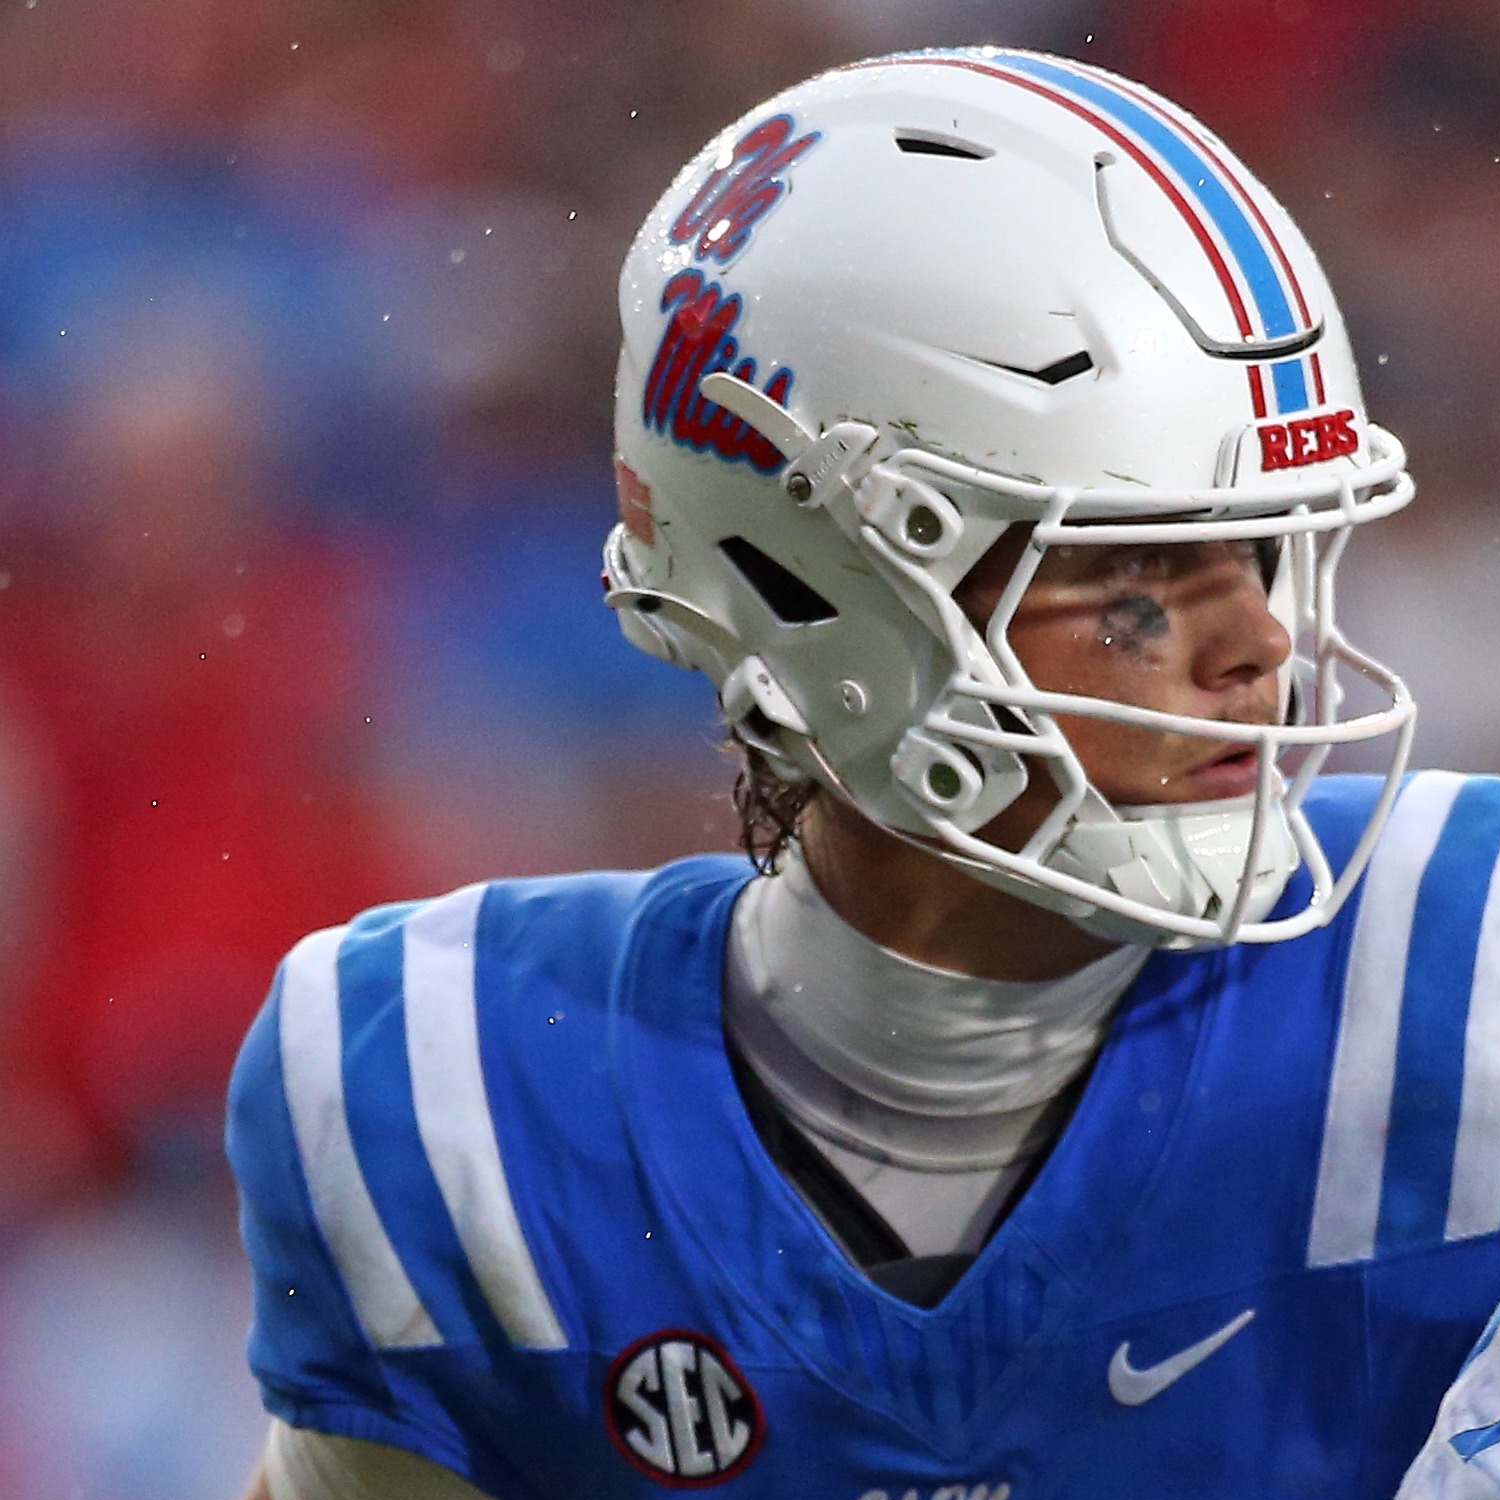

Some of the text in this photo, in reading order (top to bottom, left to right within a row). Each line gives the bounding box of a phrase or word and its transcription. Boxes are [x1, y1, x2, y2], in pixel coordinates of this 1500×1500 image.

[668, 113, 822, 264] Ole
[643, 268, 796, 476] Miss
[1257, 409, 1359, 472] REBS
[613, 1337, 748, 1479] SEC
